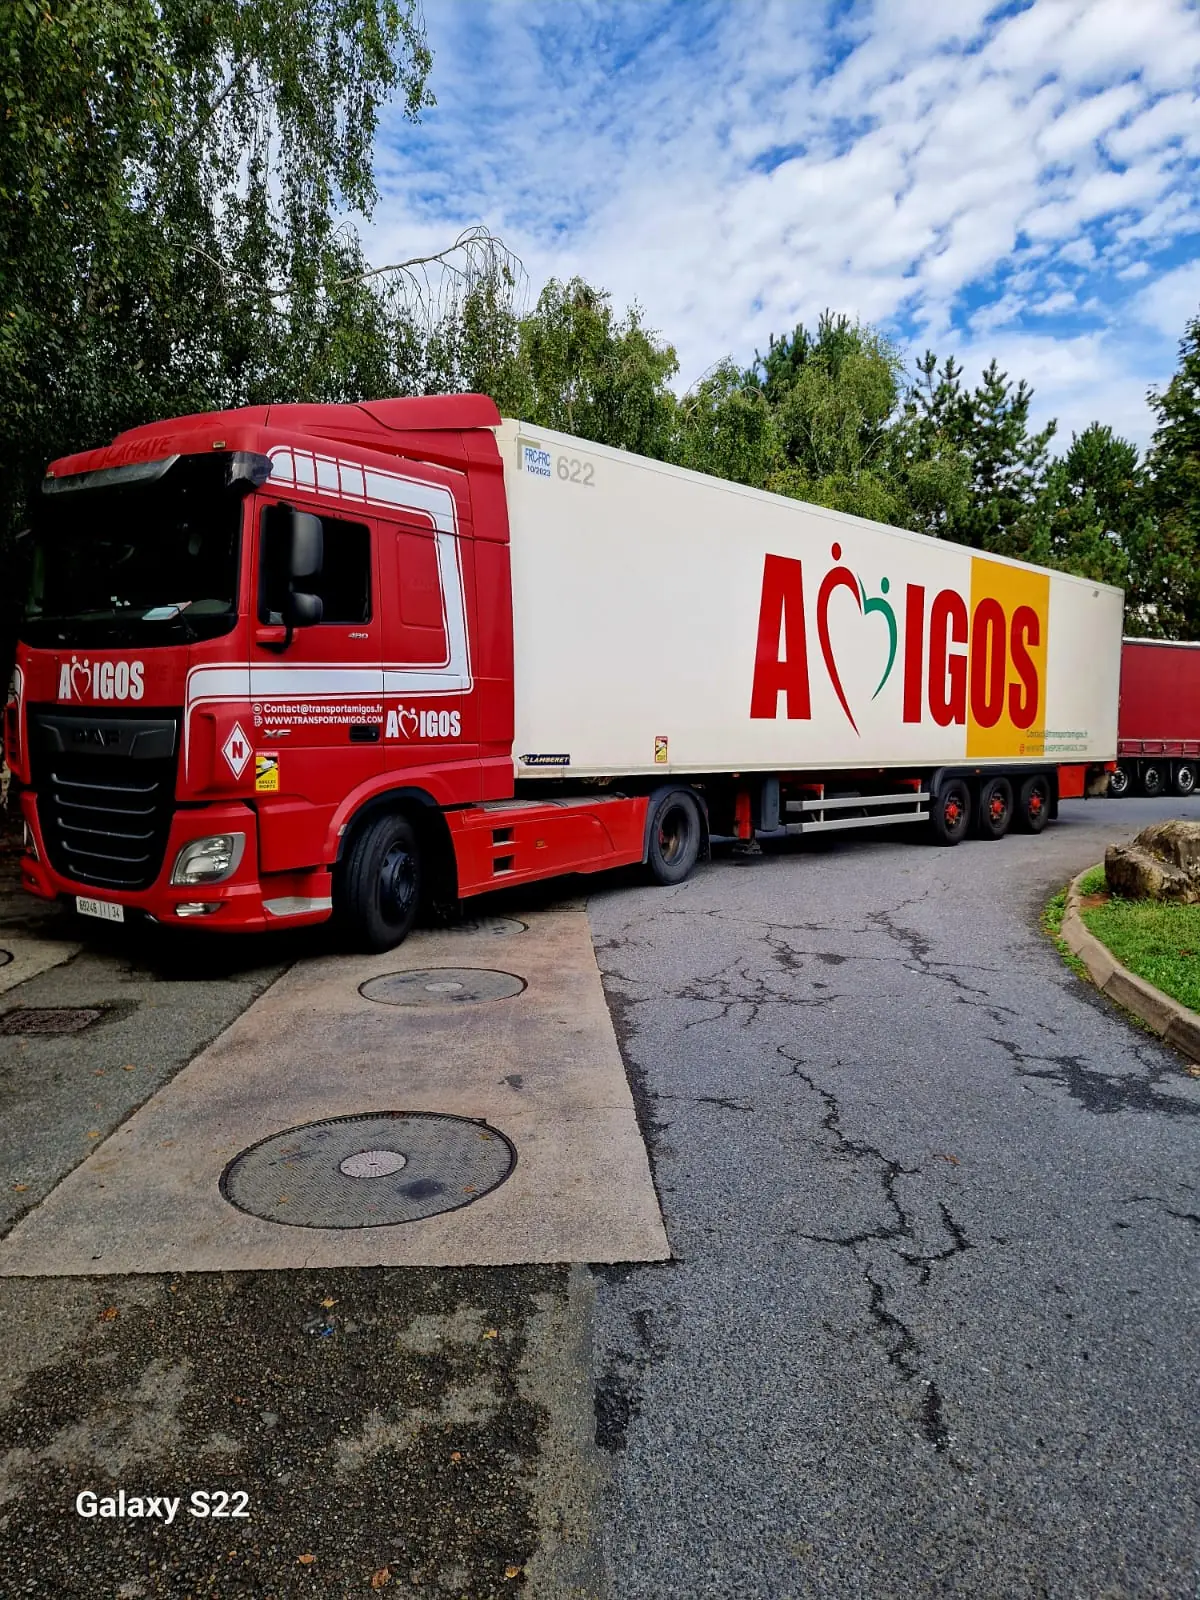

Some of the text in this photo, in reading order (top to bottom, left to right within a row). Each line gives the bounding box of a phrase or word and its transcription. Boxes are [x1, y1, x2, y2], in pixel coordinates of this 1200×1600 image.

[527, 465, 551, 477] 10/2023
[556, 455, 595, 487] 622
[263, 704, 383, 715] Contact@transportamigos.fr
[264, 715, 383, 725] WWW.TRANSPORTAMIGOS.COM
[264, 728, 292, 738] XF
[232, 741, 243, 759] N
[529, 755, 569, 764] LAMBERET
